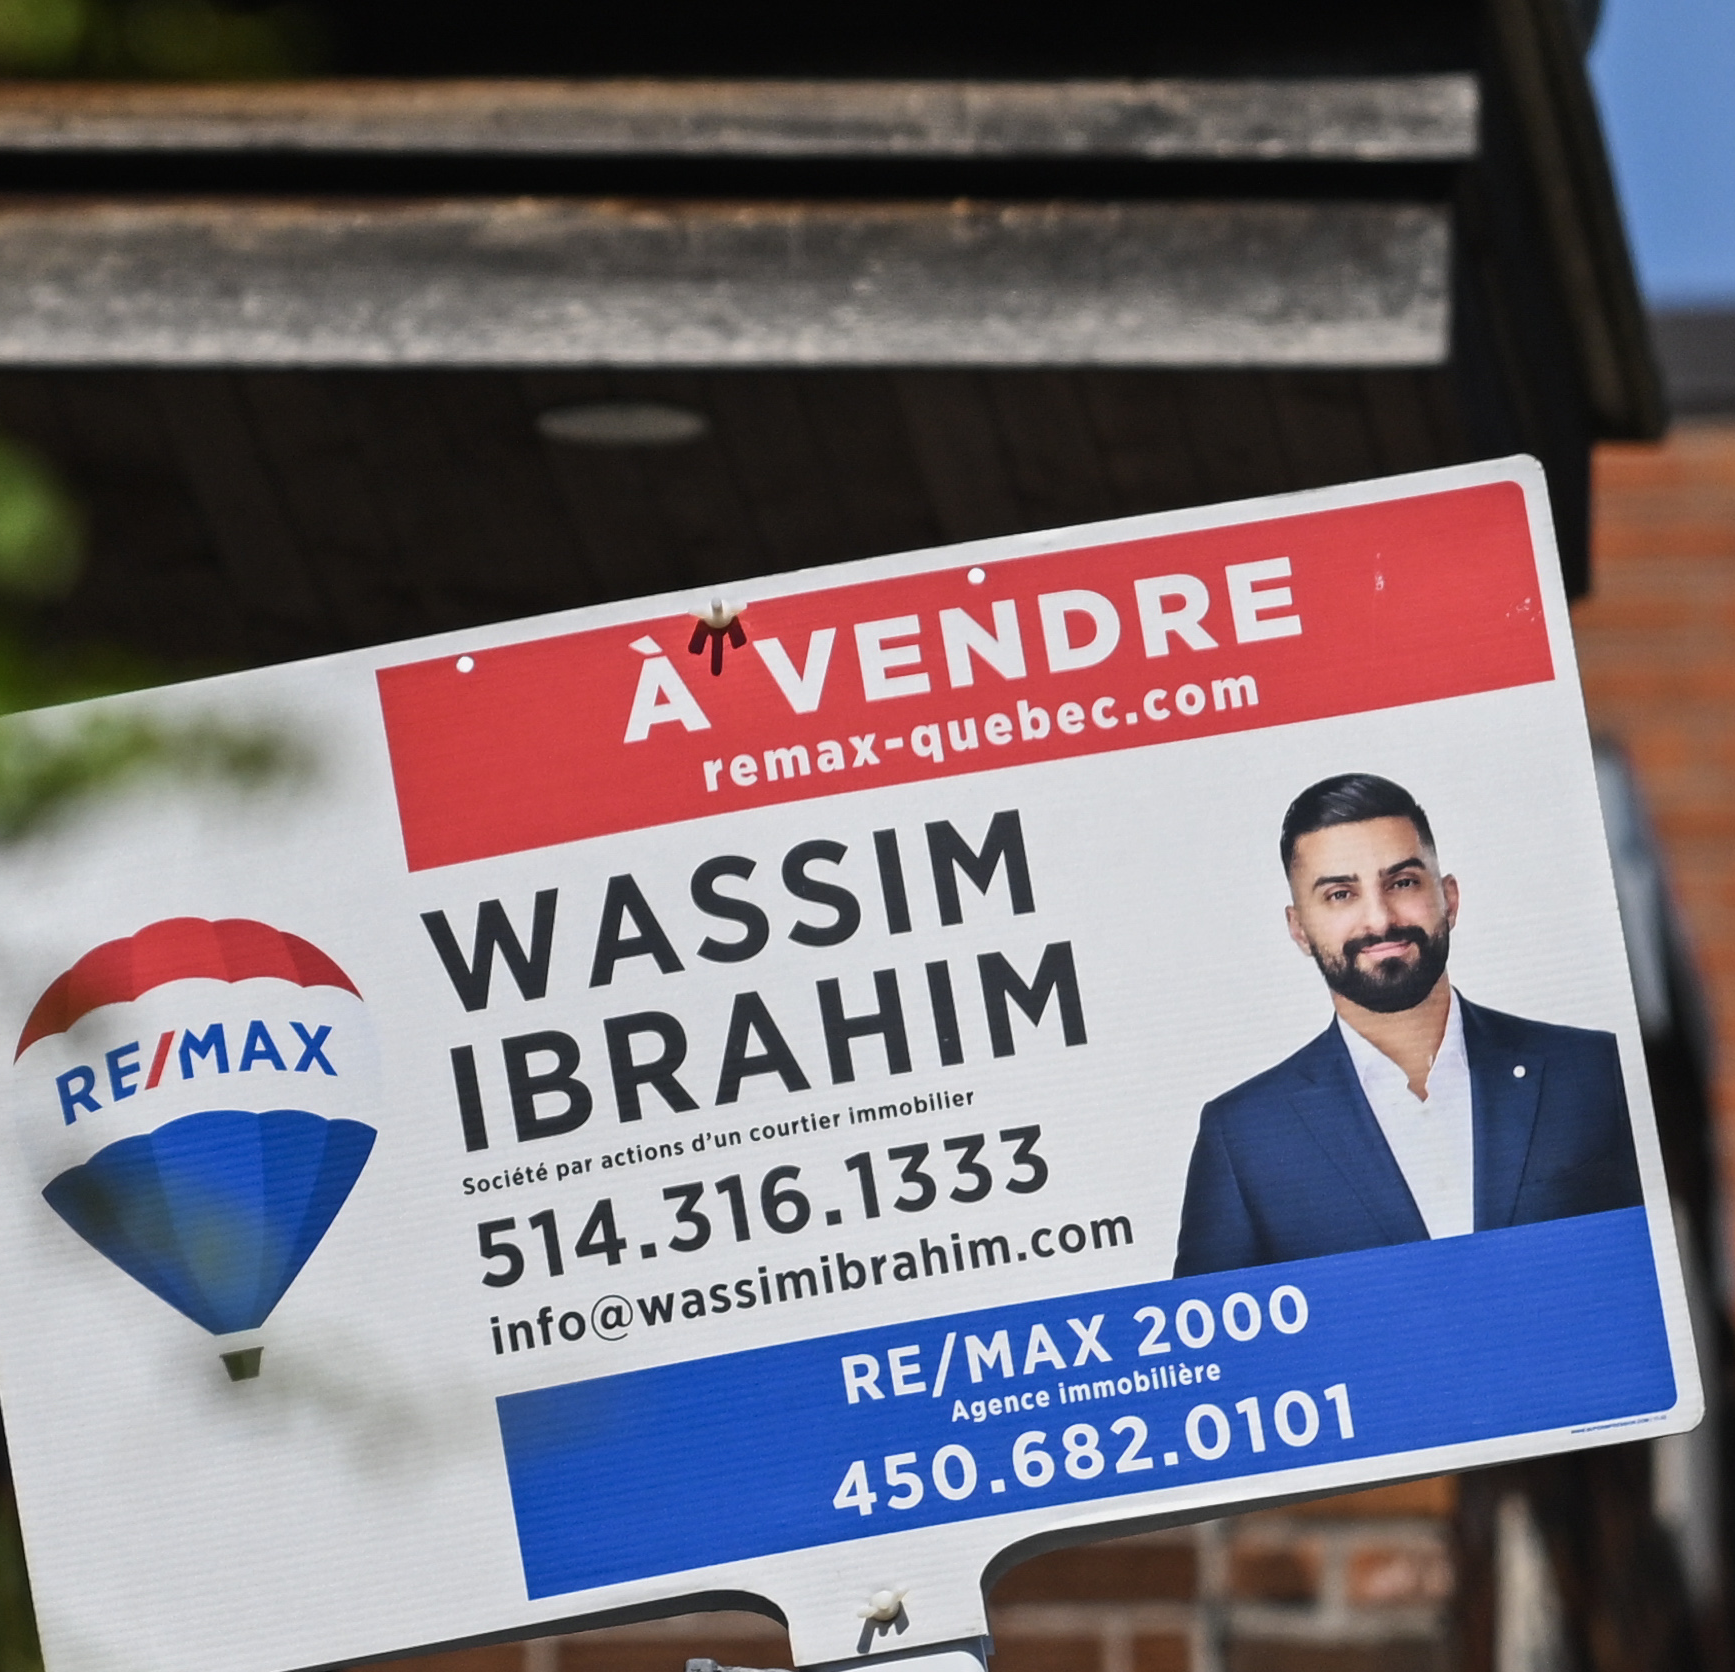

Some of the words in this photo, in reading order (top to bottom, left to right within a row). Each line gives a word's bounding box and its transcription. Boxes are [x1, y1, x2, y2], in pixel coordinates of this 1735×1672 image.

[623, 634, 712, 744] À
[752, 556, 1304, 715] VENDRE
[702, 674, 1260, 792] remax-quebec.com
[419, 808, 1037, 1013] WASSIM
[55, 1019, 338, 1126] RE/MAX
[449, 940, 1088, 1153] IBRAHIM
[462, 1159, 549, 1196] Société
[555, 1156, 593, 1181] par
[600, 1139, 685, 1170] actions
[748, 1109, 841, 1144] courtier
[848, 1088, 975, 1125] immobilier
[476, 1123, 1050, 1289] 514.316.1333
[489, 1214, 1135, 1355] info@wassimibrahim.com
[840, 1313, 1113, 1404] RE/MAX
[1132, 1284, 1310, 1356] 2000
[831, 1382, 1356, 1517] 450.682.0101
[950, 1386, 1051, 1423] Agence
[1057, 1362, 1222, 1406] immobilière
